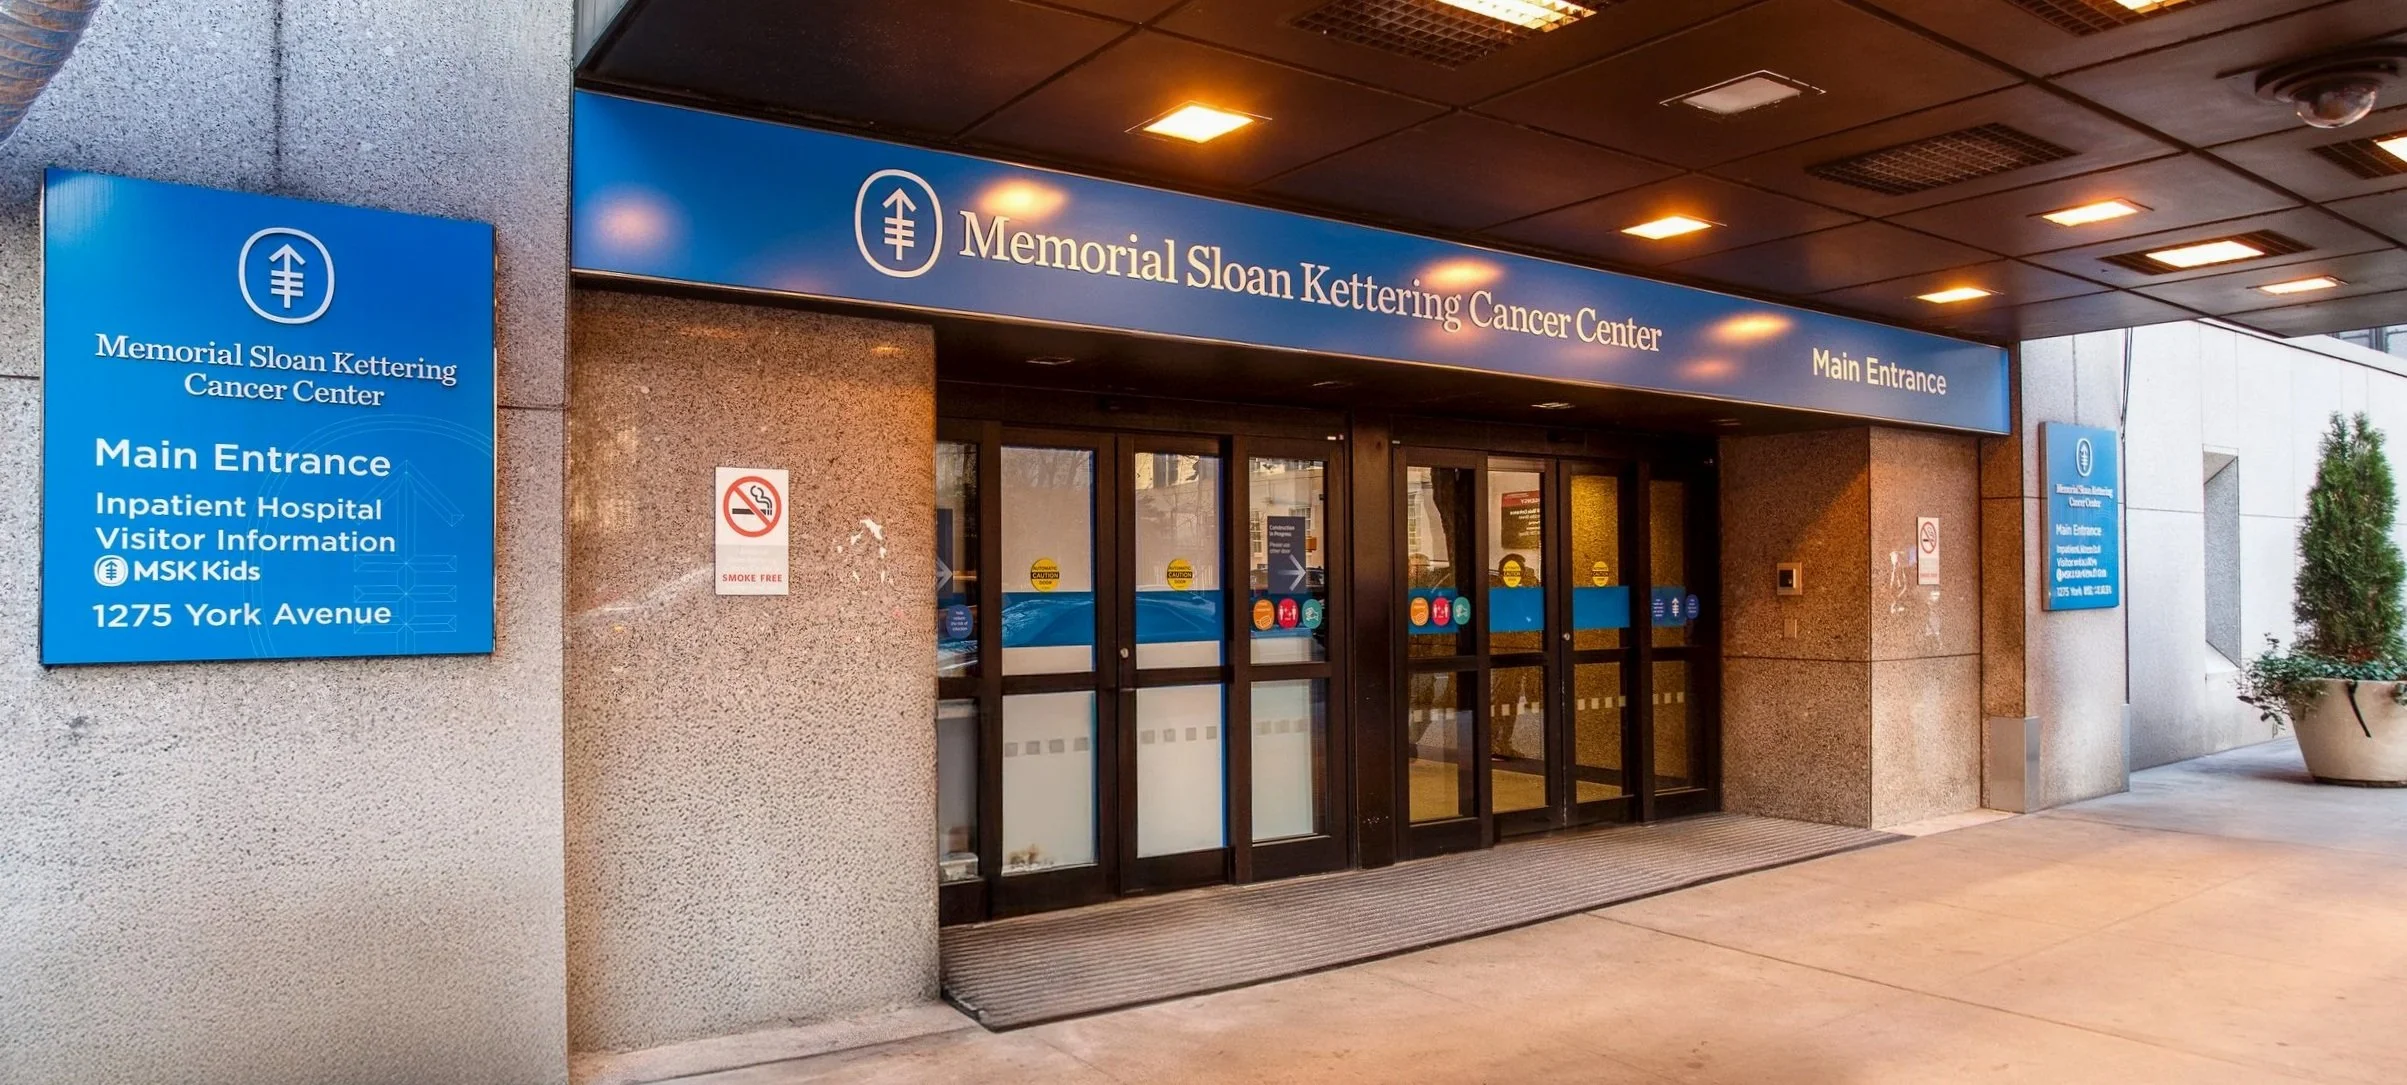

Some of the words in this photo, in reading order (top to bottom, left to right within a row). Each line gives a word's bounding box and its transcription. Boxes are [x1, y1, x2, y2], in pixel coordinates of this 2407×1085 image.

[959, 209, 1179, 284] Memorial
[1186, 245, 1293, 300] Sloan
[1300, 262, 1461, 333] Kettering
[1469, 290, 1572, 340] Cancer
[1576, 308, 1663, 353] Center
[95, 333, 243, 367] Memorial
[249, 345, 327, 373] Sloan
[331, 351, 457, 386] Kettering
[1813, 347, 1860, 383] Main
[1866, 356, 1947, 397] Entrance
[184, 372, 287, 401] Cancer
[292, 379, 385, 406] Center
[95, 437, 197, 470] Main
[214, 443, 391, 477] Entrance
[96, 492, 246, 520] Inpatient
[257, 496, 382, 523] Hospital
[95, 527, 206, 551] Visitor
[217, 528, 395, 553] Information
[2056, 524, 2073, 536] Main
[2073, 524, 2103, 536] Entrance
[134, 560, 196, 582] MSK
[202, 559, 261, 581] Kids
[722, 574, 756, 582] SMOKE
[760, 574, 783, 582] FREE
[93, 603, 172, 628] 1275
[185, 602, 262, 627] York
[272, 602, 392, 625] Avenue
